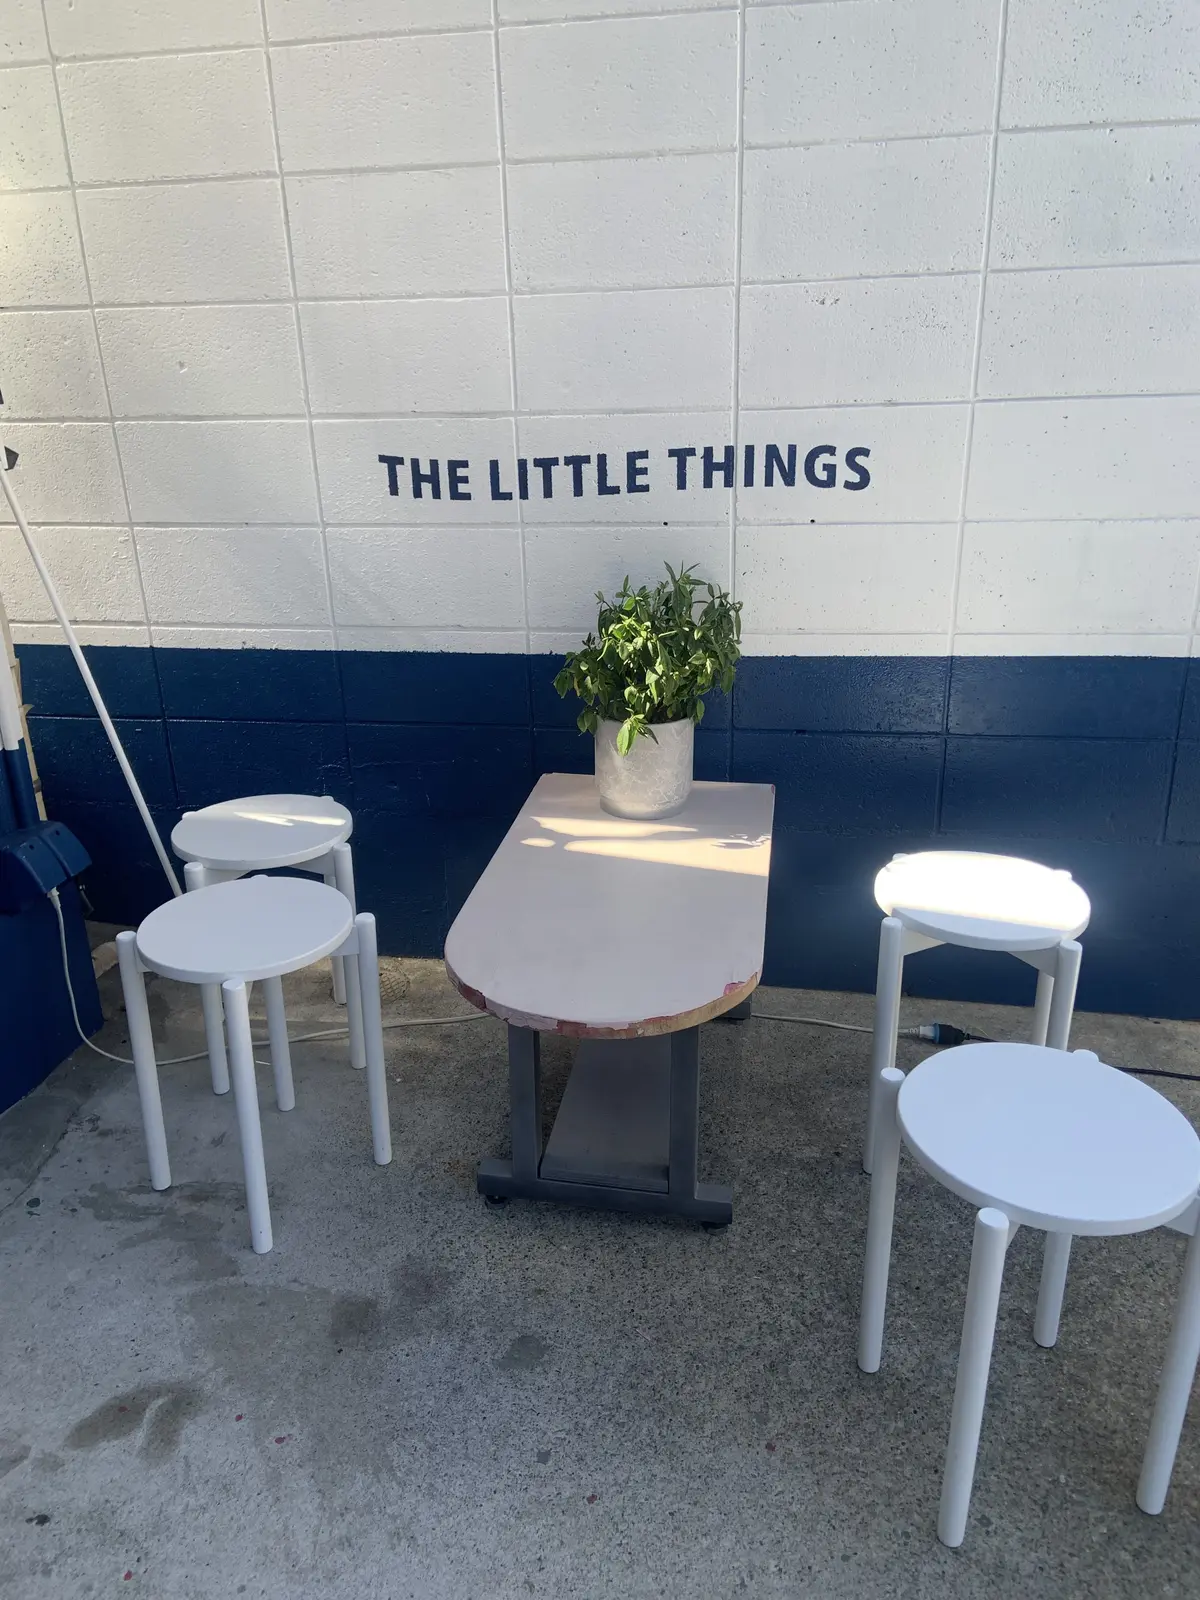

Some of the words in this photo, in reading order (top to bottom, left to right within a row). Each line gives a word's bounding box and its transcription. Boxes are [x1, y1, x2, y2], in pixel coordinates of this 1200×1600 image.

[377, 454, 472, 500] THE
[488, 449, 650, 501] LITTLE
[667, 443, 871, 493] THINGS
